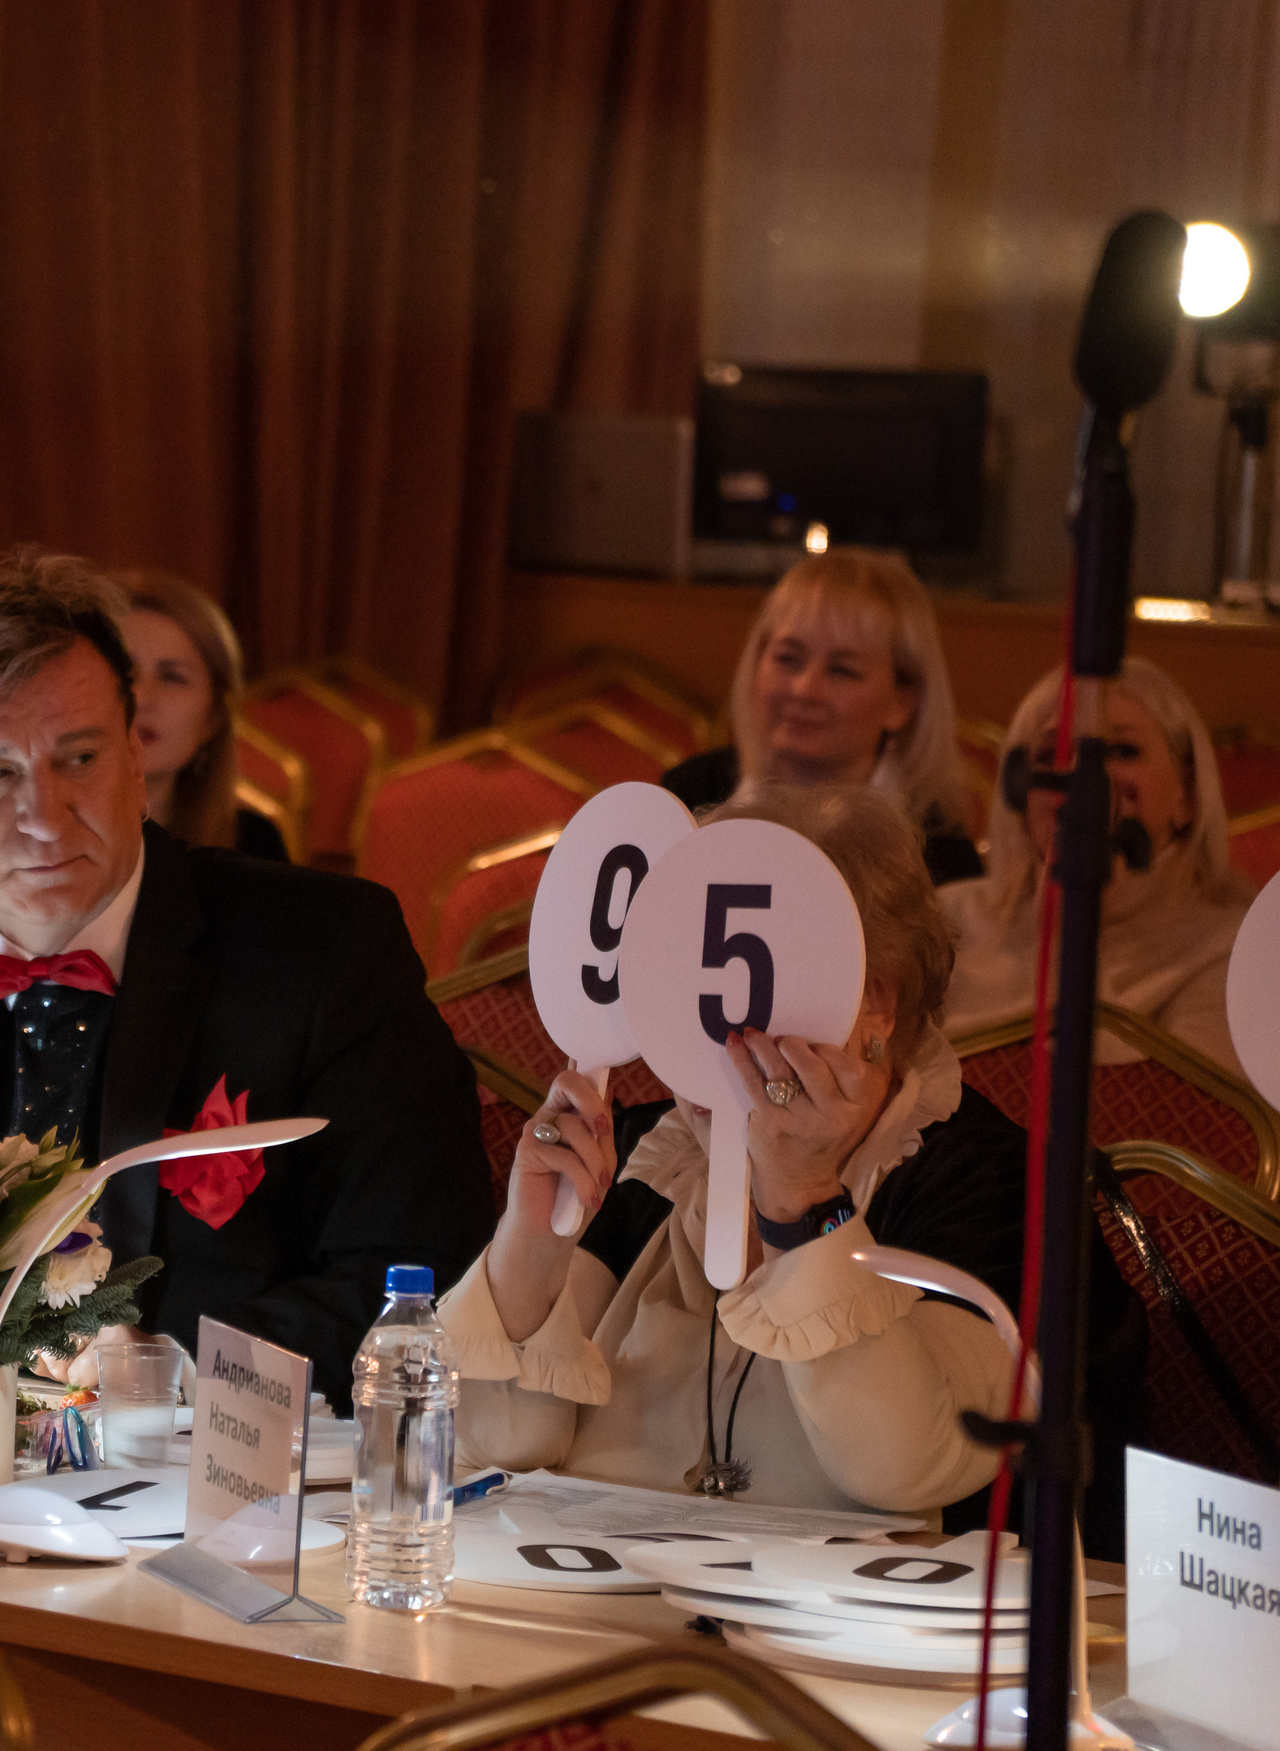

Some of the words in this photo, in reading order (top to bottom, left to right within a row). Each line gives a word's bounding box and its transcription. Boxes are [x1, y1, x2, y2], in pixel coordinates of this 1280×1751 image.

[581, 844, 649, 1005] 9
[699, 884, 774, 1046] 5
[212, 1349, 292, 1409] Андрианова
[209, 1400, 261, 1450] Наталья
[1197, 1497, 1262, 1552] Нина
[1179, 1550, 1280, 1618] Шацкая
